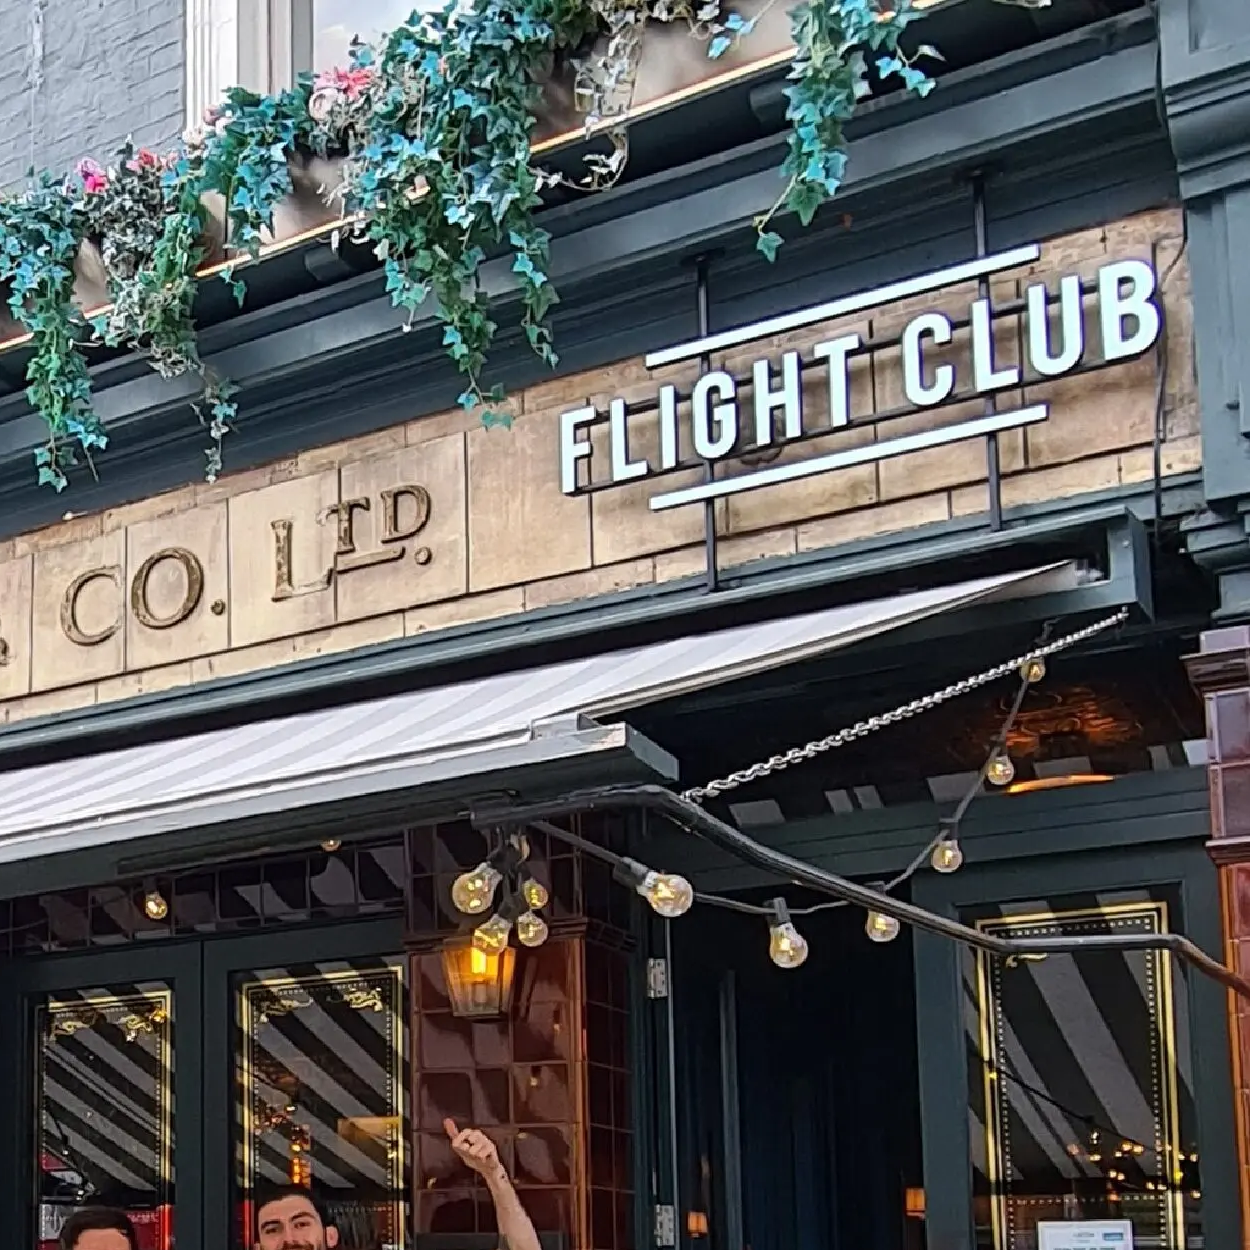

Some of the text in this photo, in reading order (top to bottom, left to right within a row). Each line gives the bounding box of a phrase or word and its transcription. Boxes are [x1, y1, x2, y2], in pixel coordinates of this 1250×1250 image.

[559, 258, 1162, 494] FLIGHT CLUB
[60, 546, 227, 647] CO.
